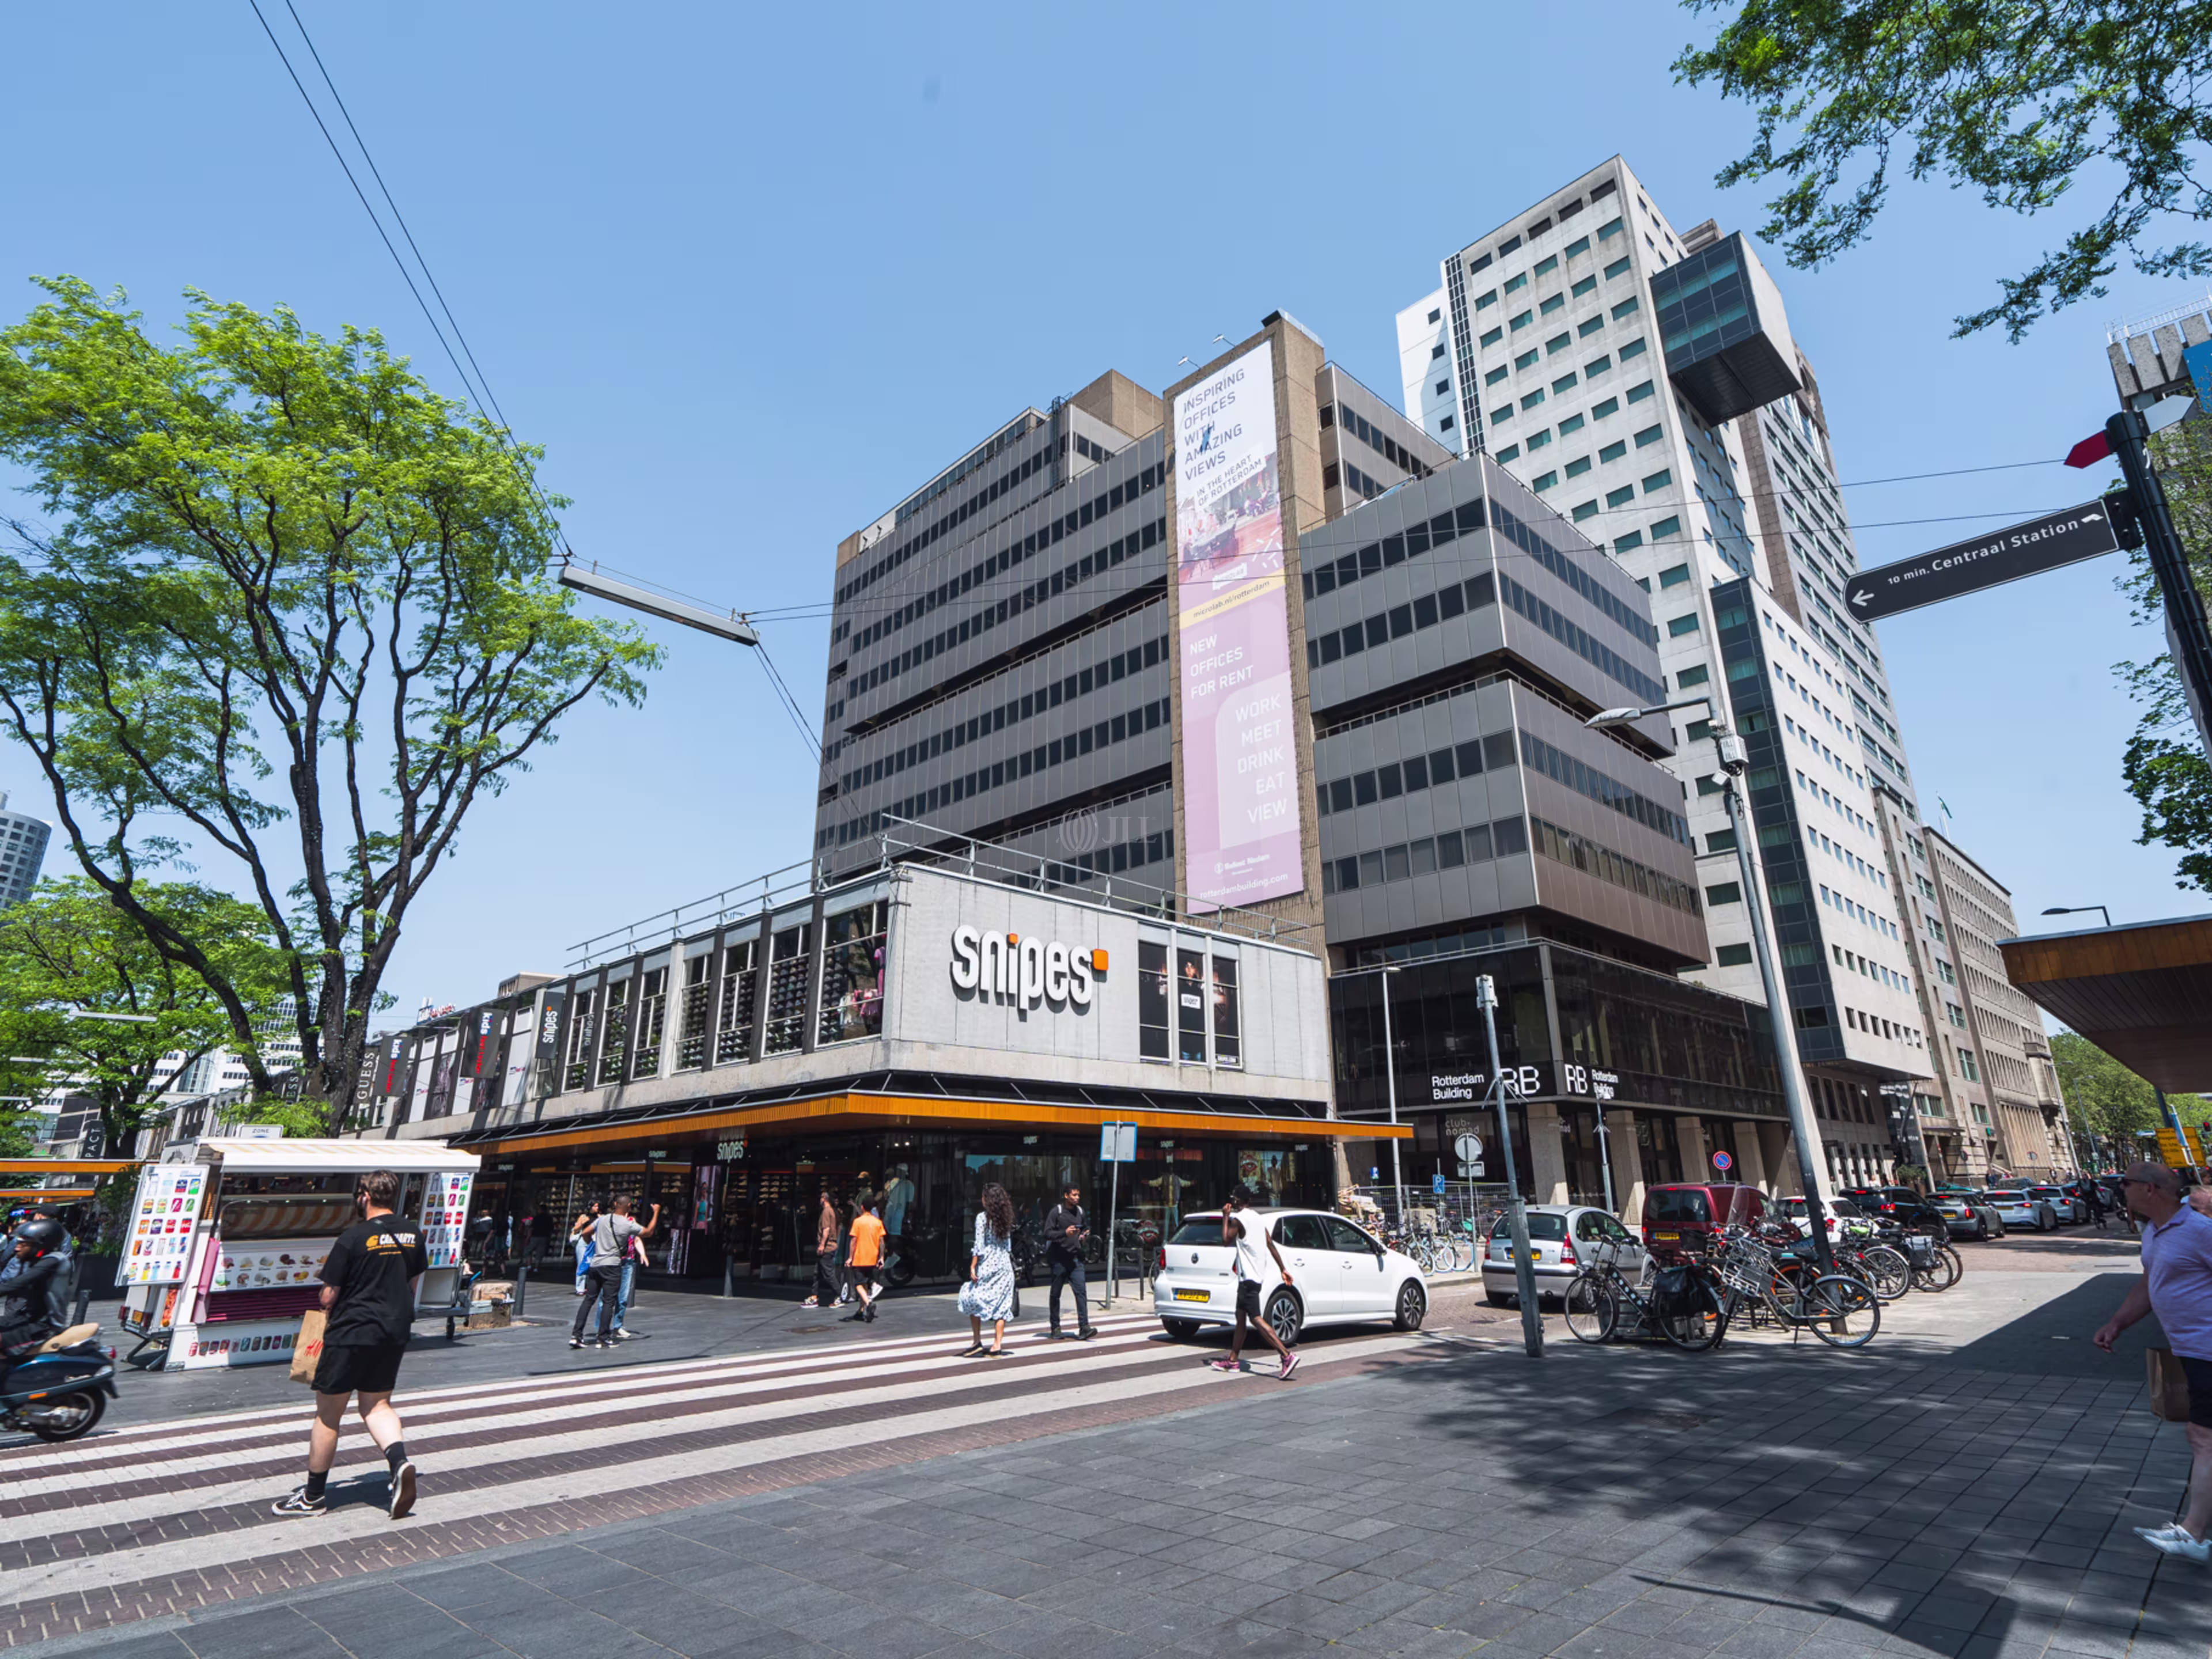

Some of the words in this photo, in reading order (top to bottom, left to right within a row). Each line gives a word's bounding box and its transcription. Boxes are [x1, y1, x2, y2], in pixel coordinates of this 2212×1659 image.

[1184, 368, 1245, 414] INSPIRING
[1184, 391, 1236, 430] OFFICES
[1184, 421, 1215, 446] WITH
[1184, 423, 1243, 464] AMAZING
[1185, 450, 1226, 480] VIEWS
[1196, 487, 1206, 497] IN
[1207, 476, 1223, 492] THE
[1224, 454, 1253, 478] HEART
[1198, 495, 1210, 507] OF
[1211, 459, 1262, 501] ROTTERDAM
[1887, 575, 1900, 585] 10
[1903, 566, 1930, 581] min.
[1931, 540, 2006, 572] Centraal
[2010, 518, 2079, 548] Station
[1190, 634, 1217, 656] NEW
[1190, 646, 1244, 677] OFFICES
[1190, 679, 1216, 700] FOR
[1219, 664, 1254, 690] RENT
[1235, 693, 1281, 722] WORK
[1241, 719, 1282, 747] MEET
[1237, 746, 1285, 775] DRINK
[1255, 771, 1285, 796] EAT
[1247, 797, 1288, 824] VIEW
[1200, 873, 1289, 899] rotterdambuilding.com
[952, 925, 1093, 1009] snipes
[480, 1012, 493, 1035] kids
[543, 1010, 558, 1044] snipes
[390, 1039, 403, 1059] kids
[357, 1052, 375, 1100] GUESS
[1432, 1072, 1484, 1087] Rotterdam
[1499, 1066, 1540, 1094] RB
[1564, 1064, 1588, 1094] RB
[1592, 1069, 1619, 1084] Rotterdam
[1433, 1088, 1472, 1100] Building
[1446, 1124, 1480, 1136] nomad
[717, 1141, 744, 1163] snipes
